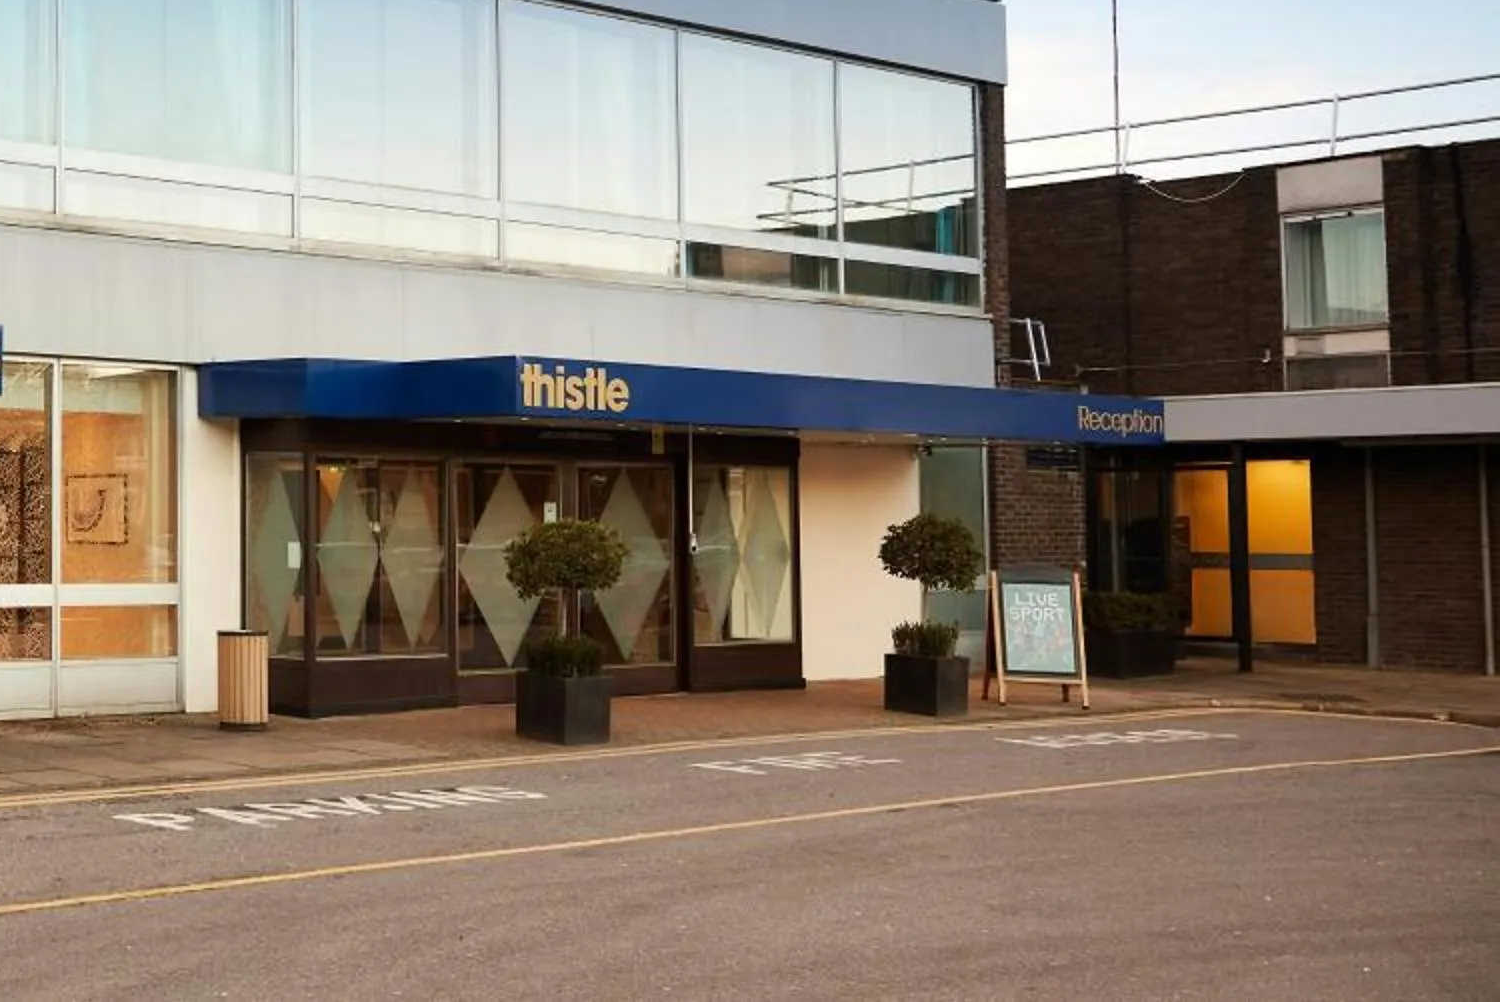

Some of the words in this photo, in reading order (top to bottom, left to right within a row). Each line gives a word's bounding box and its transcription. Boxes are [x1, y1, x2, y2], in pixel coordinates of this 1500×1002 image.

[520, 363, 629, 412] thistle
[1077, 405, 1163, 438] Reception
[1009, 606, 1067, 625] SPORT
[1013, 590, 1061, 608] LIVE
[111, 782, 549, 831] PARKING
